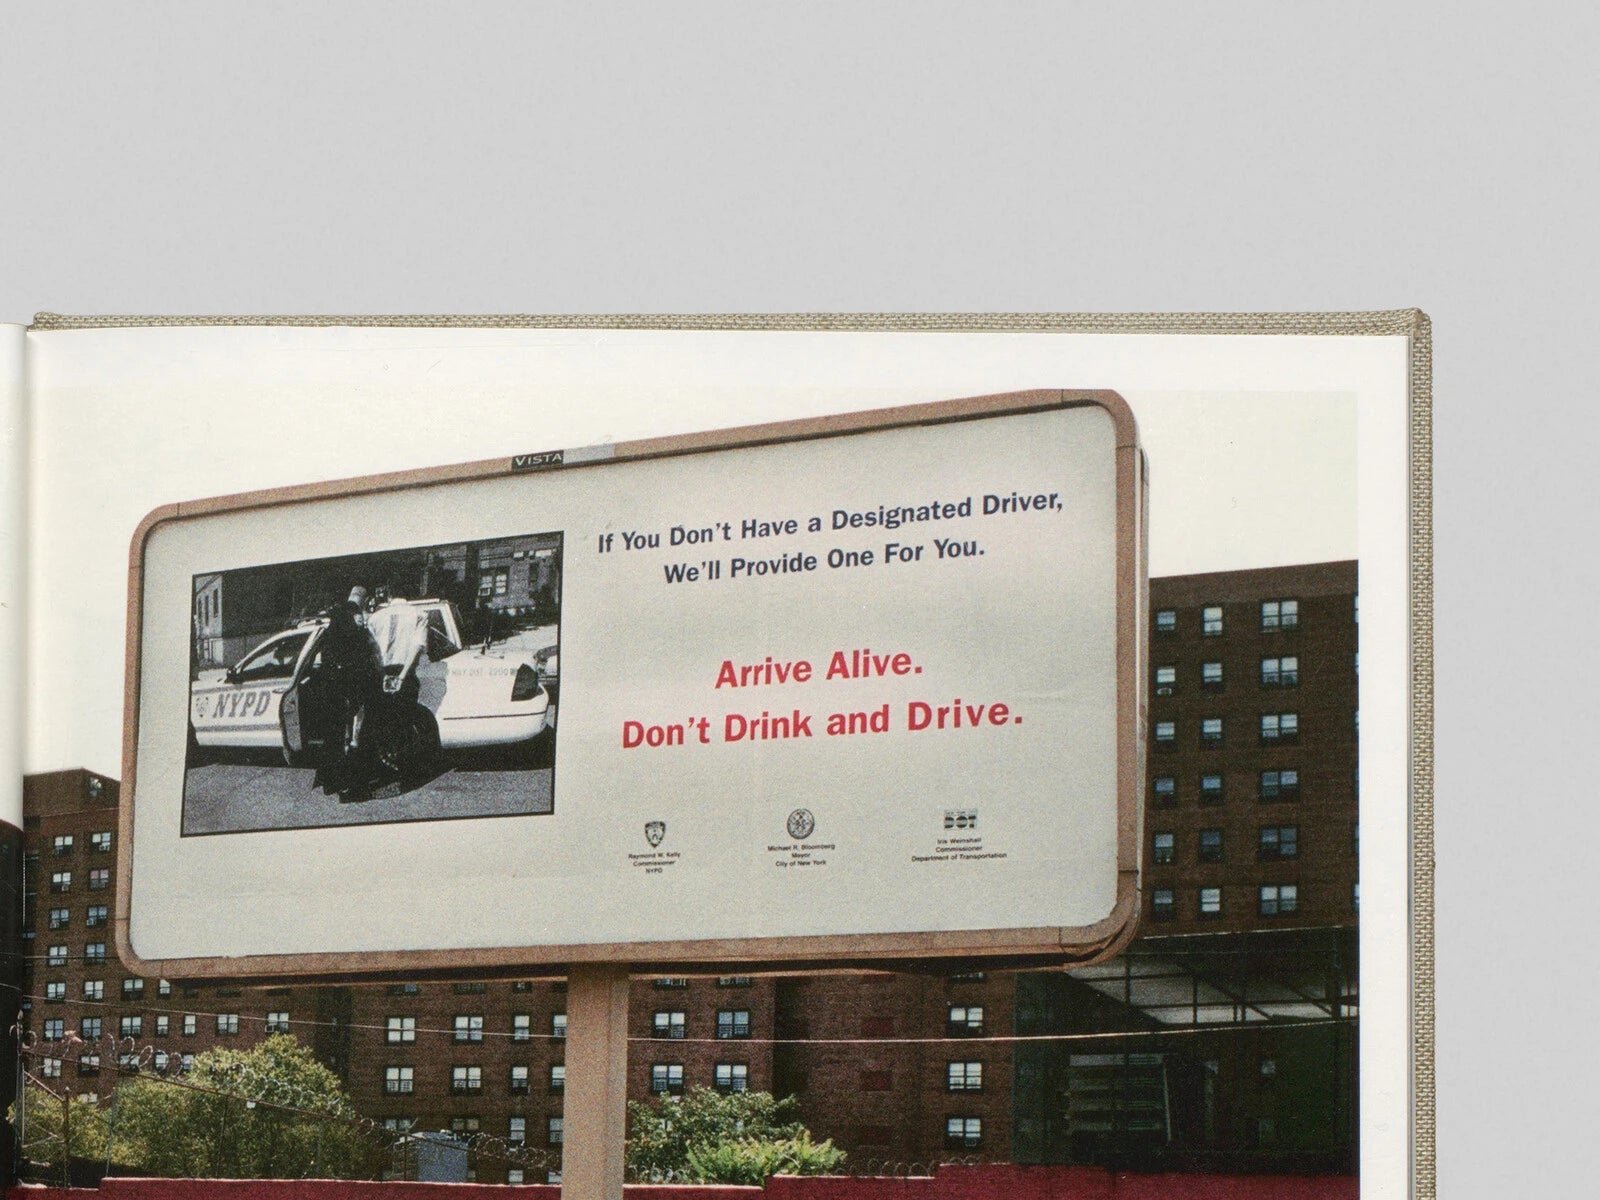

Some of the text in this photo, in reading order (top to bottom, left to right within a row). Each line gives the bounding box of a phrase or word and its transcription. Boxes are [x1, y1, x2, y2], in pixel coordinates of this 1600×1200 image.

[514, 453, 562, 466] VISTA
[598, 491, 1063, 553] If You Don't Have a Designated Driver,
[663, 537, 986, 584] We'll Provide One For You.
[715, 648, 923, 689] Arrive Alive.
[212, 690, 272, 719] NYPD
[622, 699, 1023, 748] Don't Drink and Drive.
[666, 851, 681, 859] Kelly
[775, 860, 788, 868] City
[911, 854, 949, 862] Department
[959, 852, 1008, 861] Transportation
